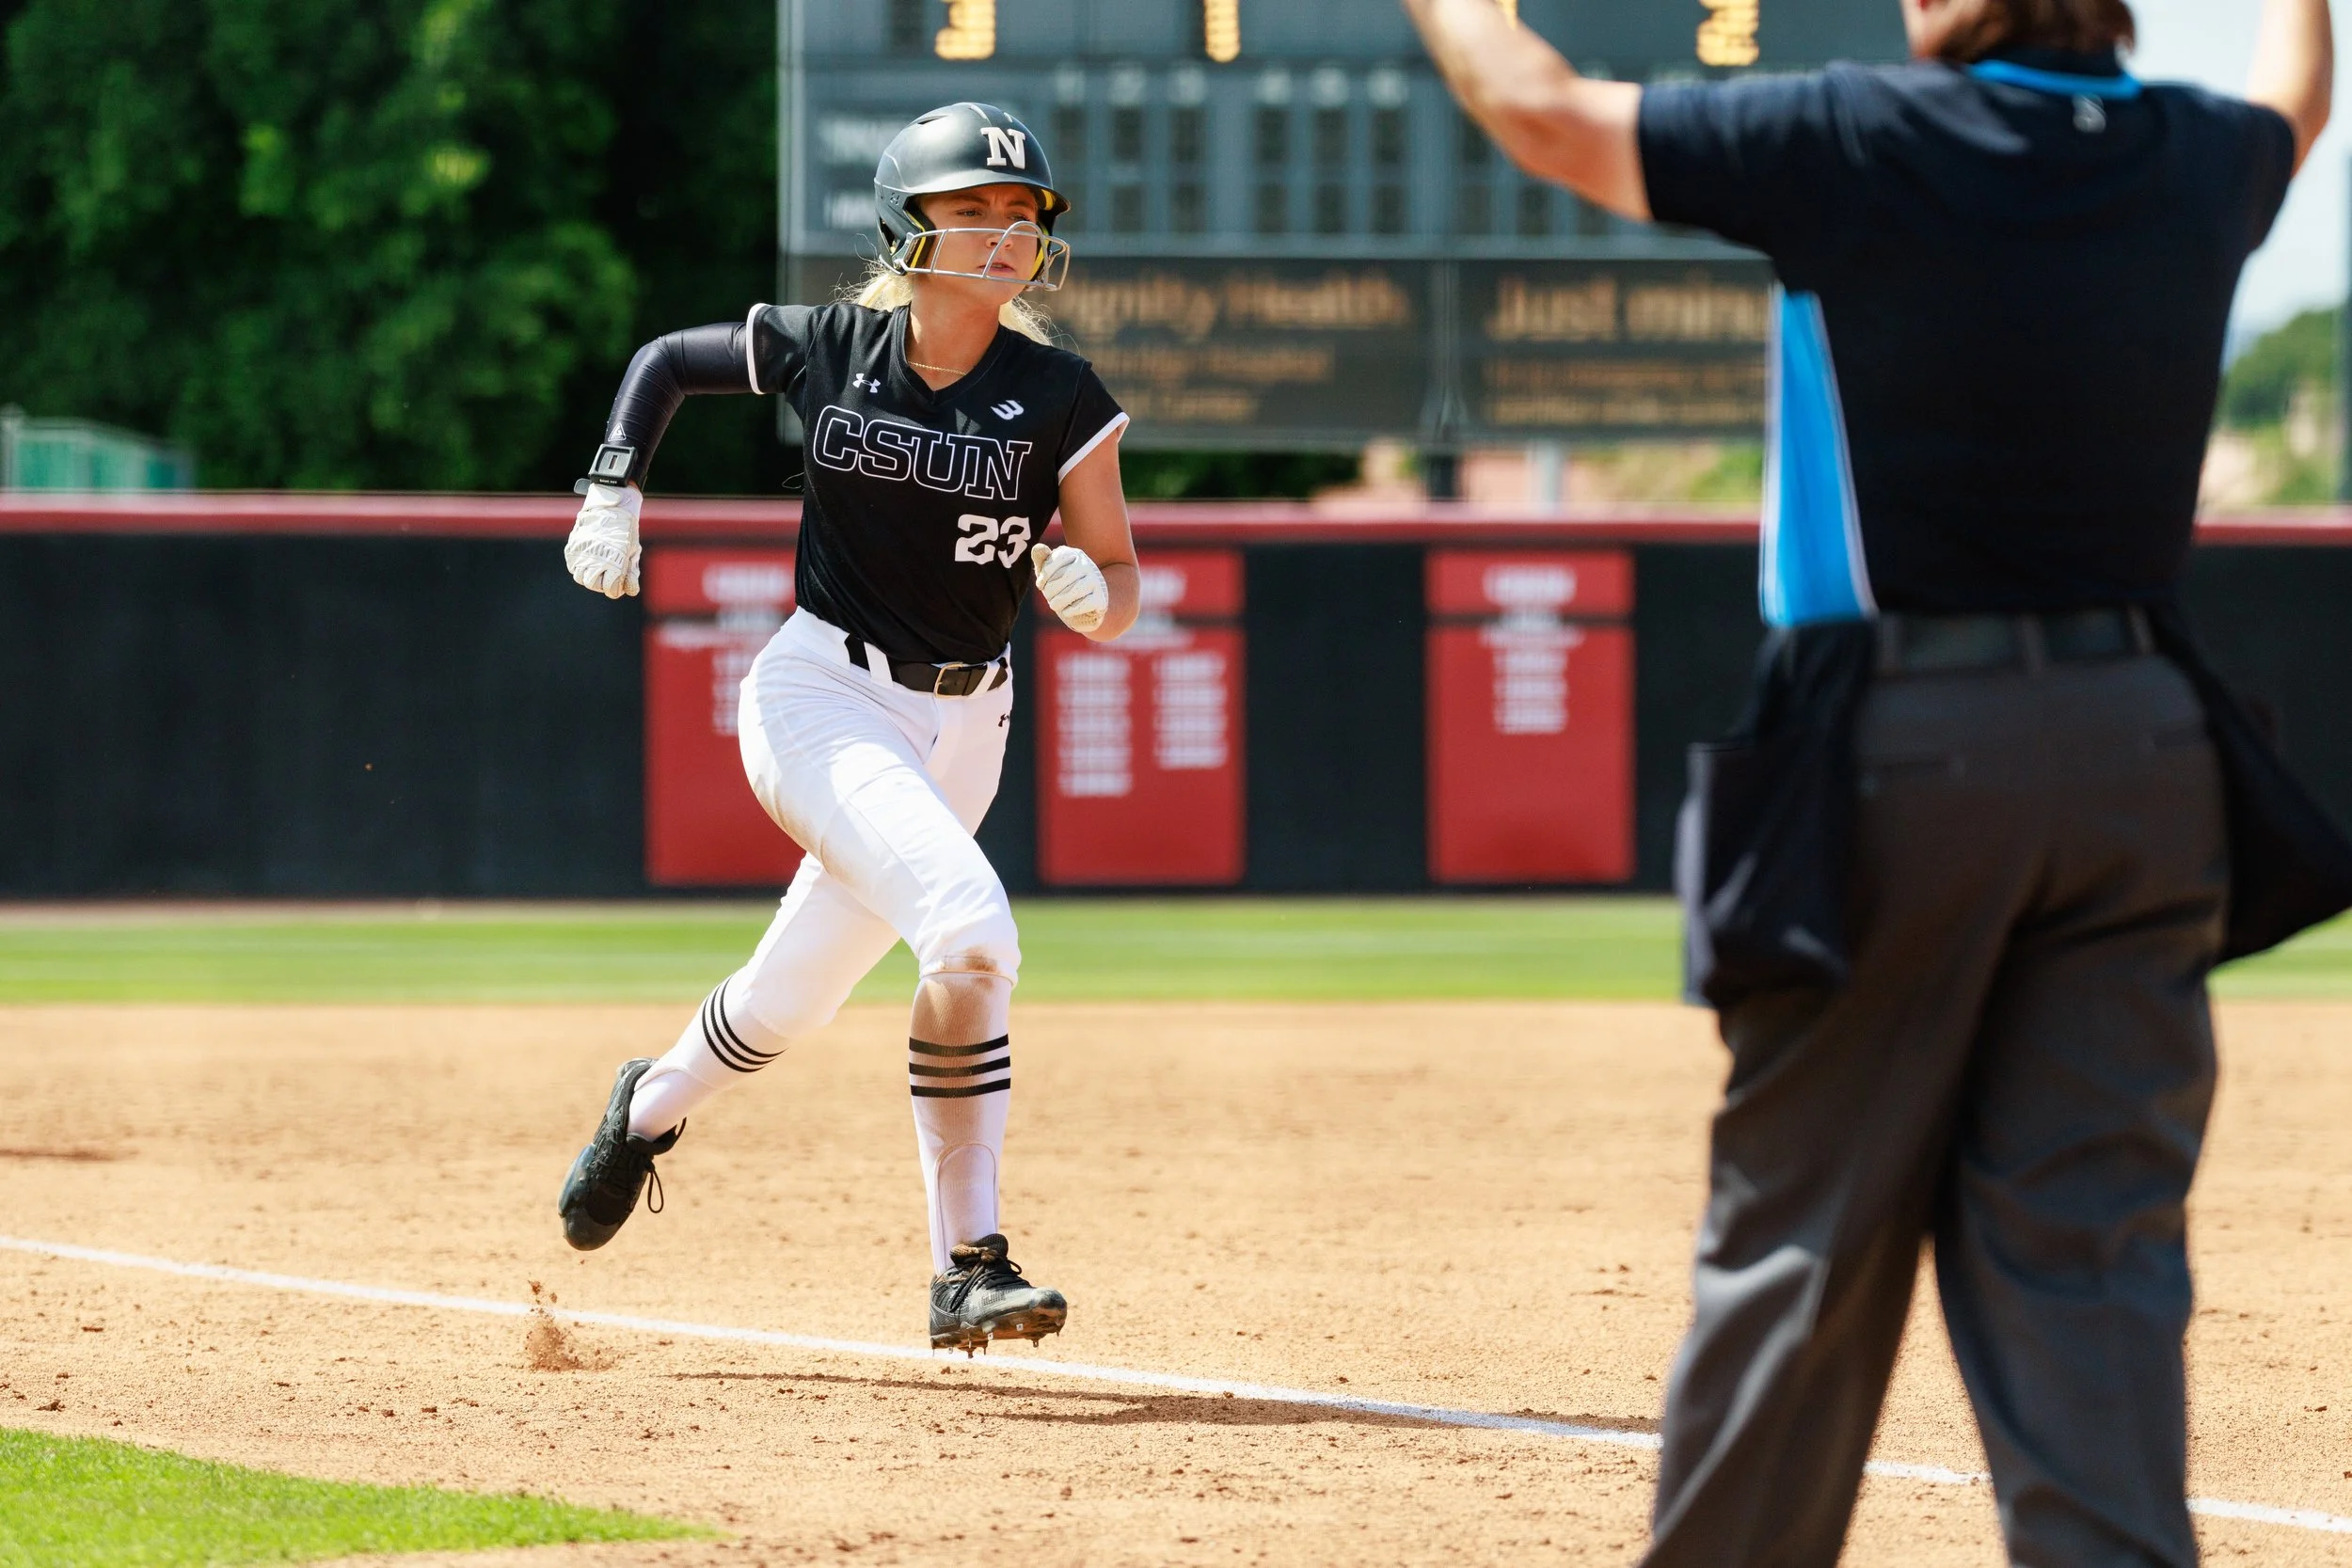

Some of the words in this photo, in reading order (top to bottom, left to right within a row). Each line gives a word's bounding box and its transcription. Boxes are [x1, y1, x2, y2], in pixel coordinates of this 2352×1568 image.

[980, 126, 1025, 169] N
[813, 404, 1033, 500] CSUN
[954, 514, 1031, 568] 23
